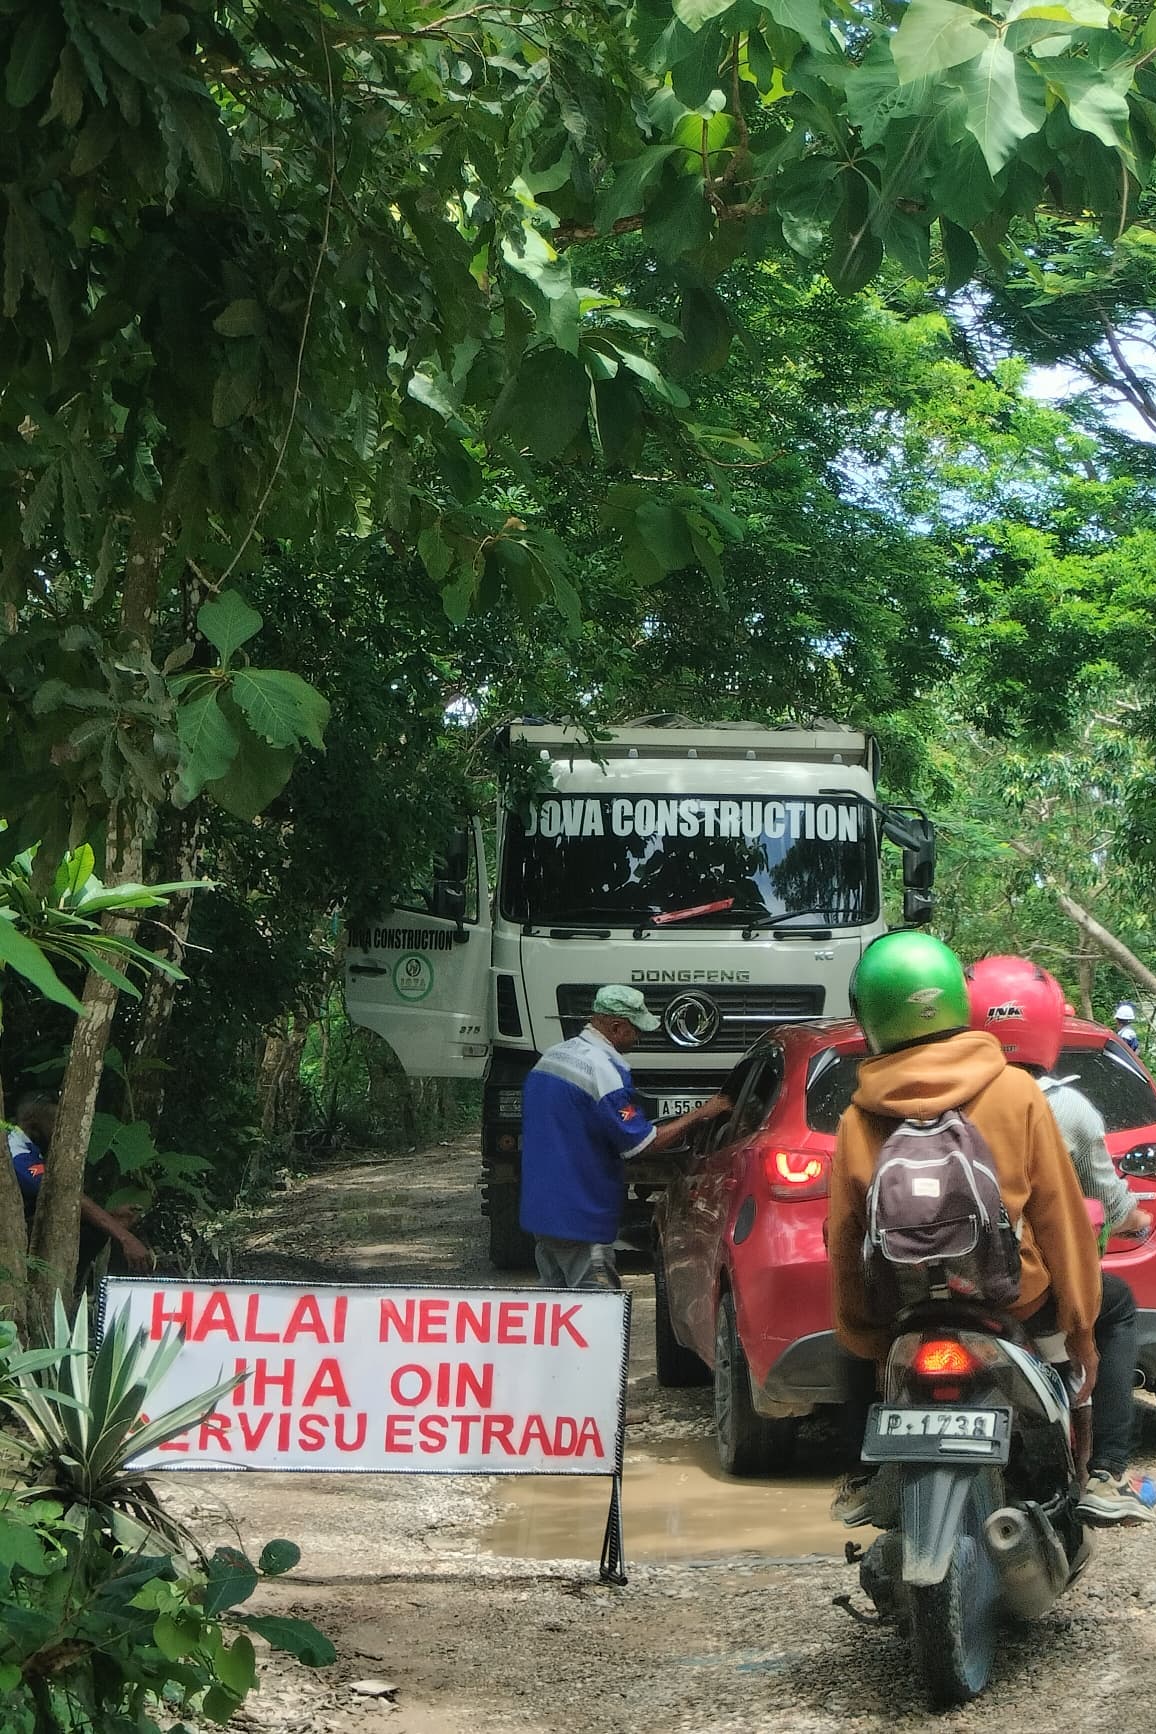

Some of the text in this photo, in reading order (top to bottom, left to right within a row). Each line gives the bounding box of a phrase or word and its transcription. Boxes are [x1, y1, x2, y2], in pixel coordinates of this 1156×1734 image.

[524, 798, 859, 843] JOVA CONSTRUCTION
[373, 927, 454, 951] CONSTRUCTION
[814, 951, 834, 961] KC
[631, 969, 750, 983] DONGFENG
[987, 1006, 1022, 1018] INK
[150, 1291, 589, 1348] HALAI NENEIK
[232, 1358, 494, 1408] IHA OIN
[122, 1411, 605, 1458] RVISU ESTRADA
